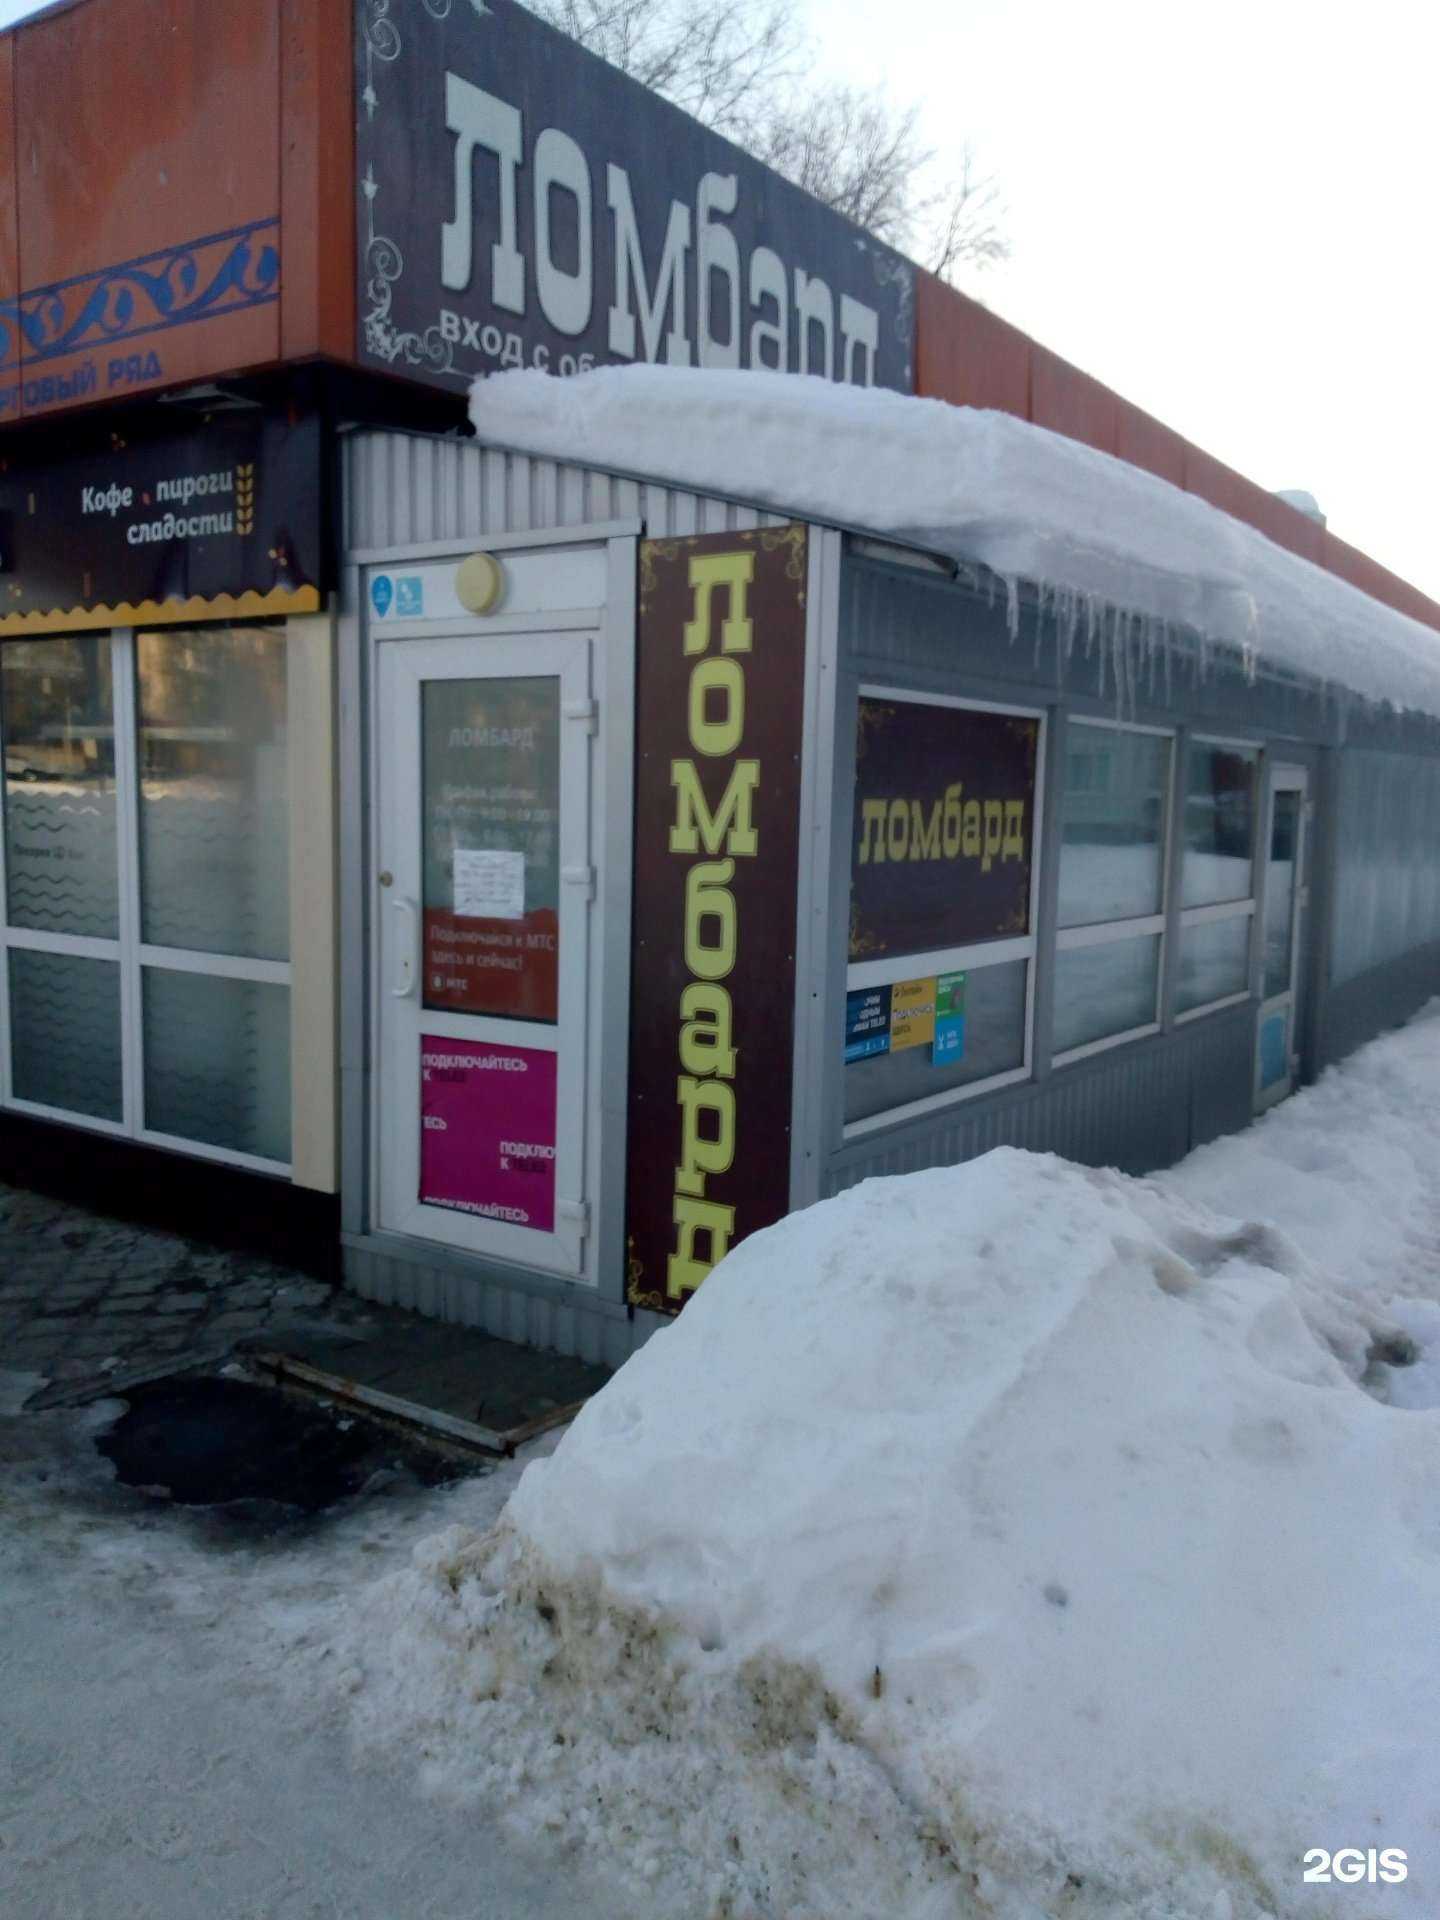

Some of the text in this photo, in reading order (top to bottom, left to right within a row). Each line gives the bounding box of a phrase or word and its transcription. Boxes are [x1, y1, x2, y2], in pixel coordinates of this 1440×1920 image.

[108, 351, 162, 387] РЯД
[82, 471, 233, 517] Кофе пироги
[127, 512, 233, 544] сладости
[422, 1053, 528, 1072] ПОДКЛЮЧАЙТЕСЬ
